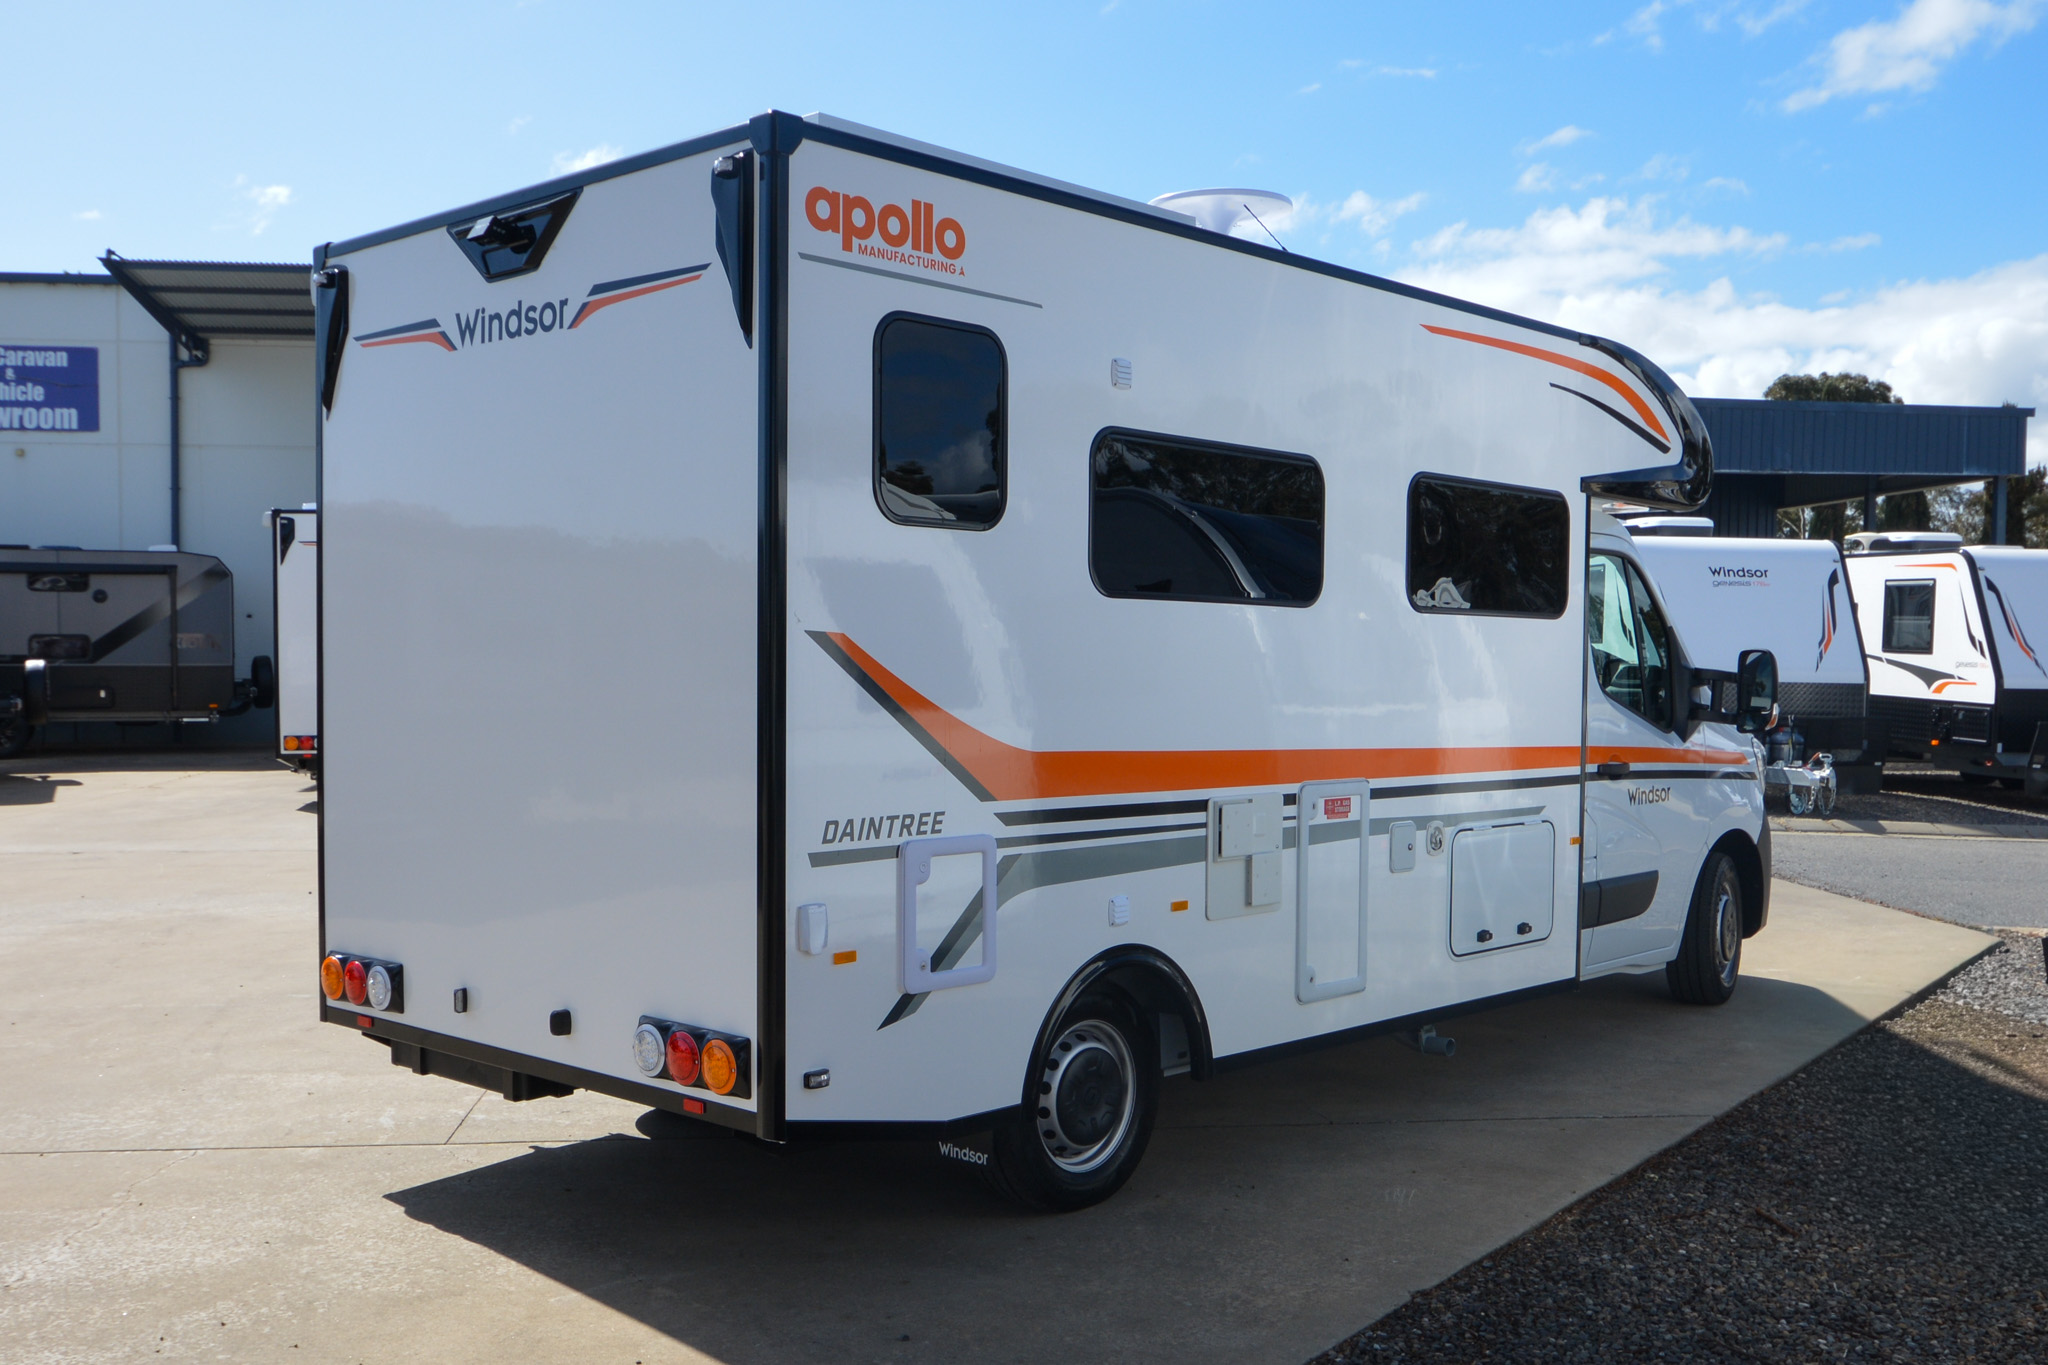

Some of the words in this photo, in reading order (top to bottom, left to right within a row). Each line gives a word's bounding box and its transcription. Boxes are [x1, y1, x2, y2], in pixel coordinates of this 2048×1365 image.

[805, 186, 966, 260] apollo
[858, 243, 957, 275] MANUFACTURING
[455, 298, 569, 347] Windsor
[5, 368, 16, 380] &
[1708, 566, 1768, 578] Windsor
[1627, 785, 1671, 806] Windsor
[821, 811, 946, 845] DAINTREE
[938, 1141, 988, 1165] Windsor
